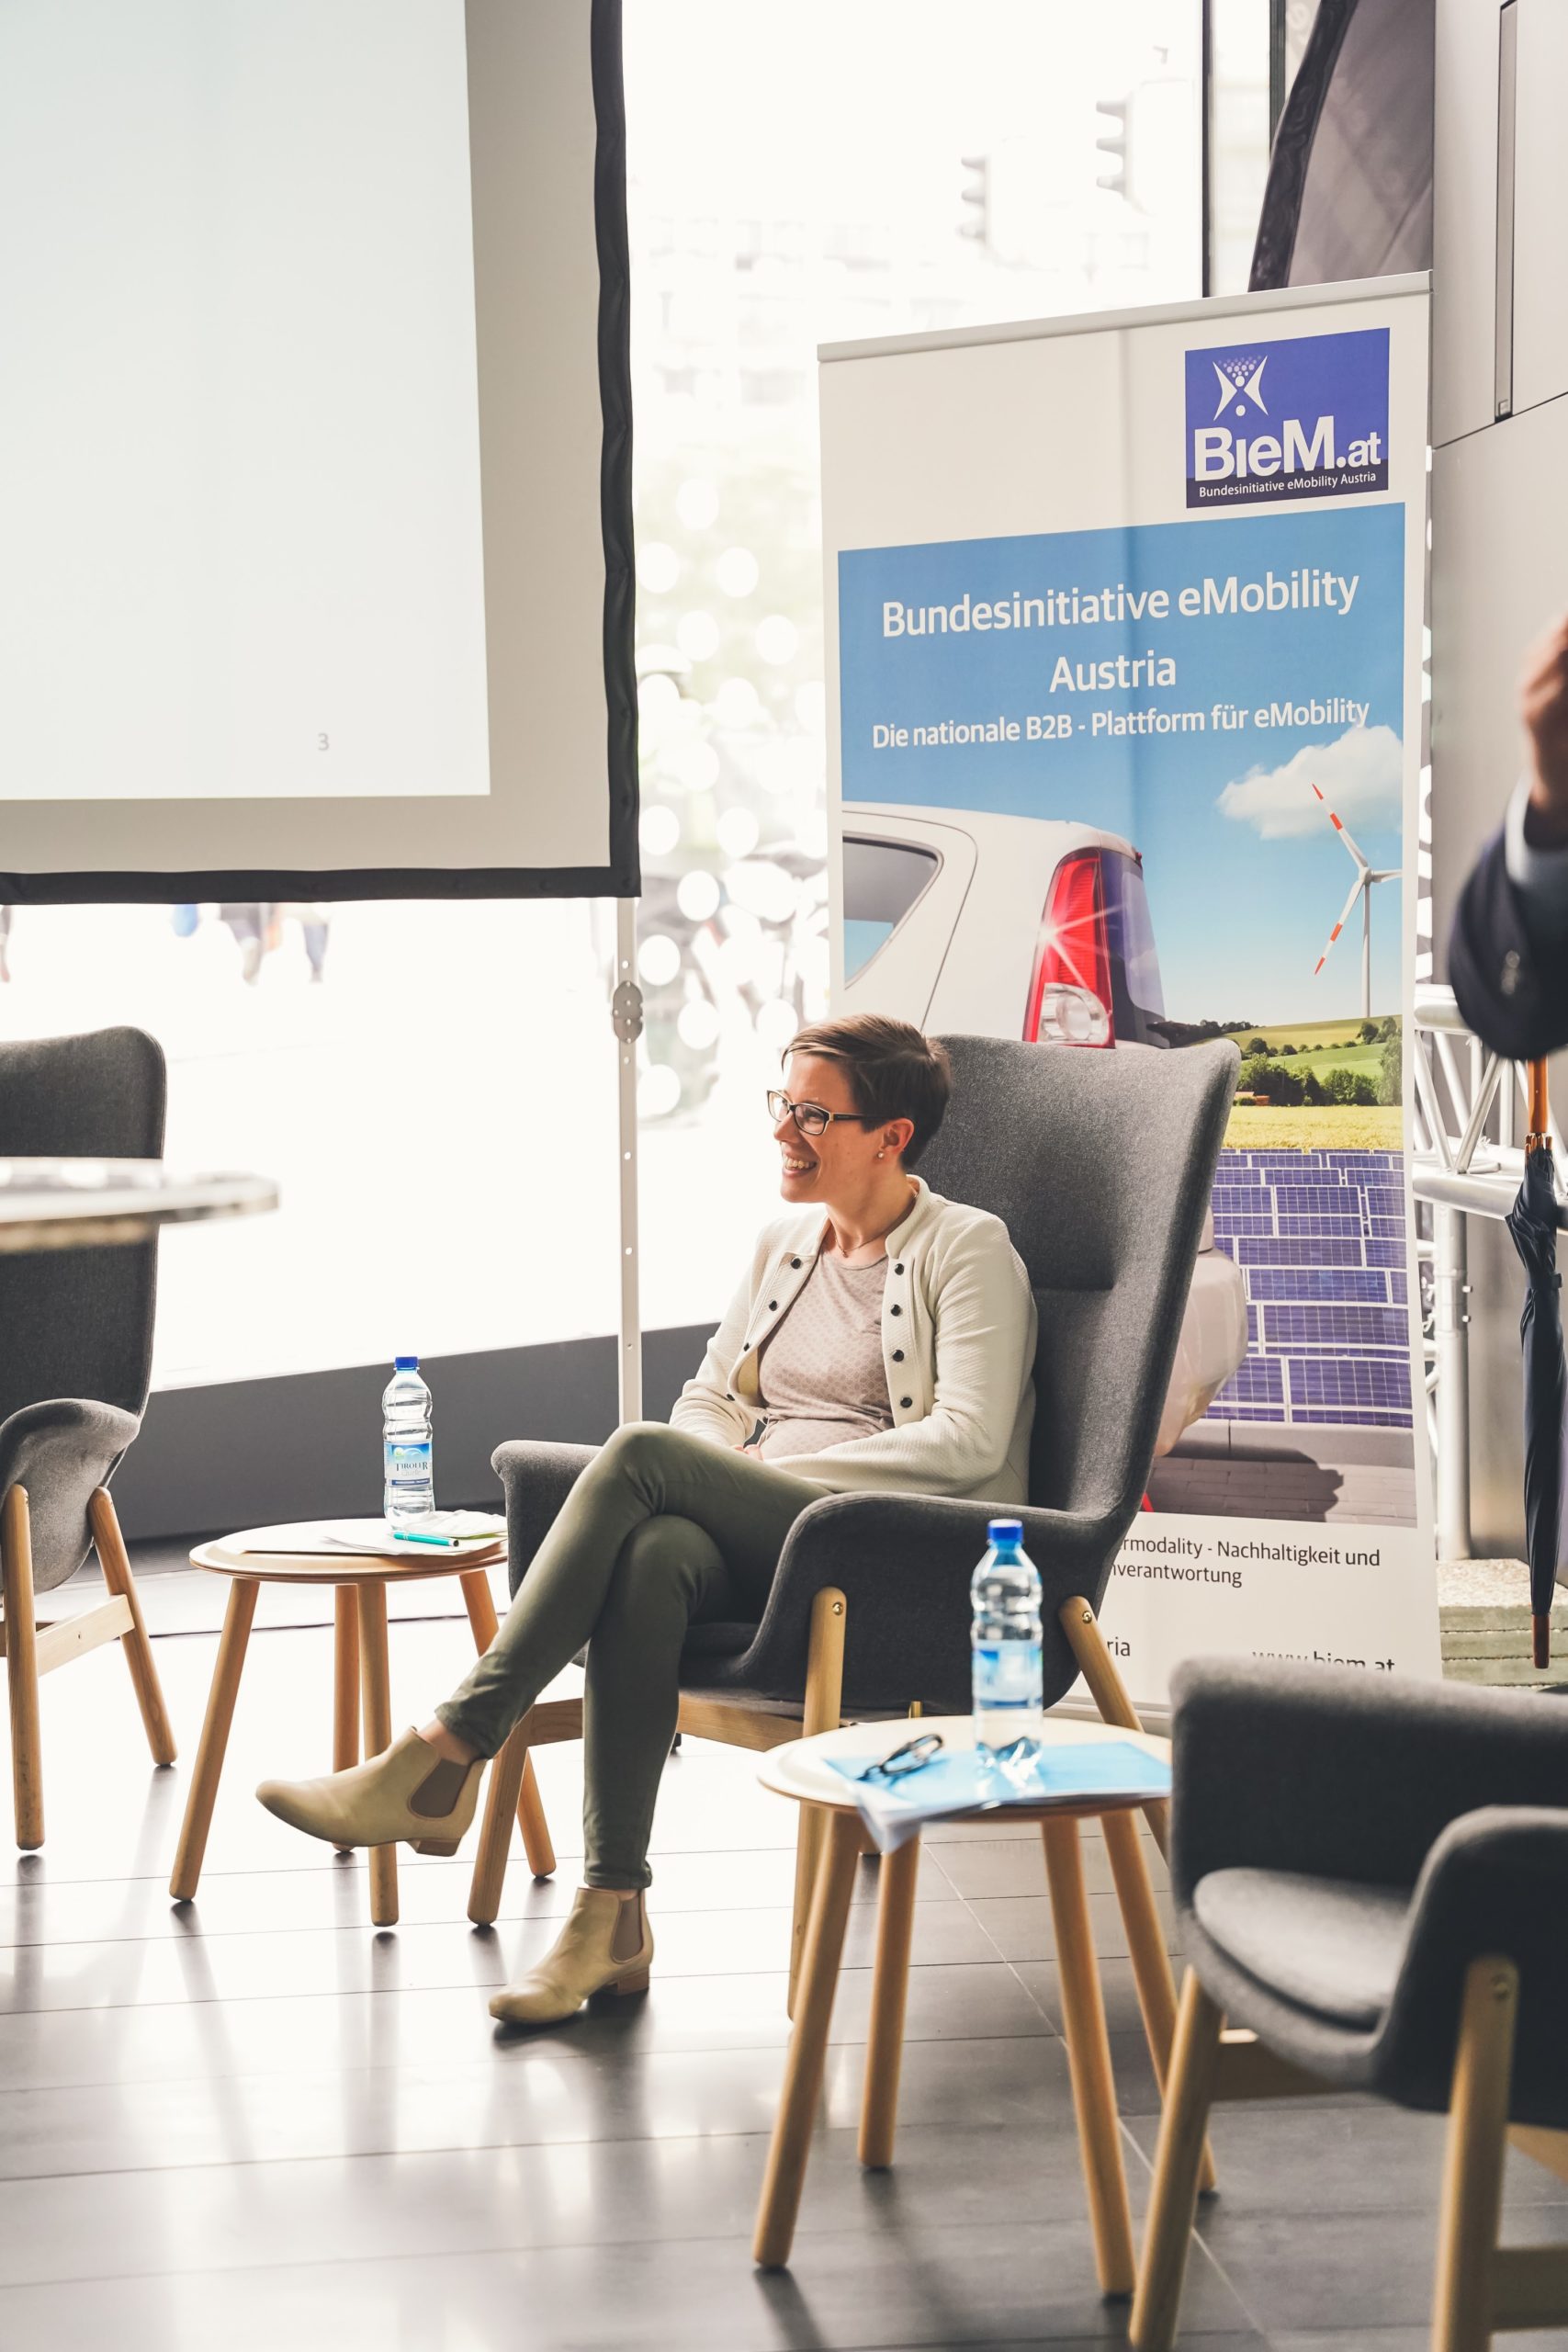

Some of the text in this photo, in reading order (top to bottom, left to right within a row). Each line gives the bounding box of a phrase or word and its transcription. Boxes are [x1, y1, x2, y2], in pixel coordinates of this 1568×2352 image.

[1194, 415, 1382, 481] BieM.at
[1199, 471, 1376, 498] Bundesinitiative eMobility Austria
[883, 569, 1359, 638] Bundesinitiative eMobility
[1049, 650, 1176, 693] Austria
[318, 732, 330, 752] 3
[873, 723, 908, 749] Die
[913, 716, 1021, 746] nationale
[1026, 714, 1073, 741] B2B
[1091, 707, 1205, 736] Plattform
[1211, 704, 1249, 729] für
[1254, 697, 1370, 729] eMobility
[1217, 1540, 1341, 1566] Nachhaltigkeit
[1345, 1549, 1381, 1566] und
